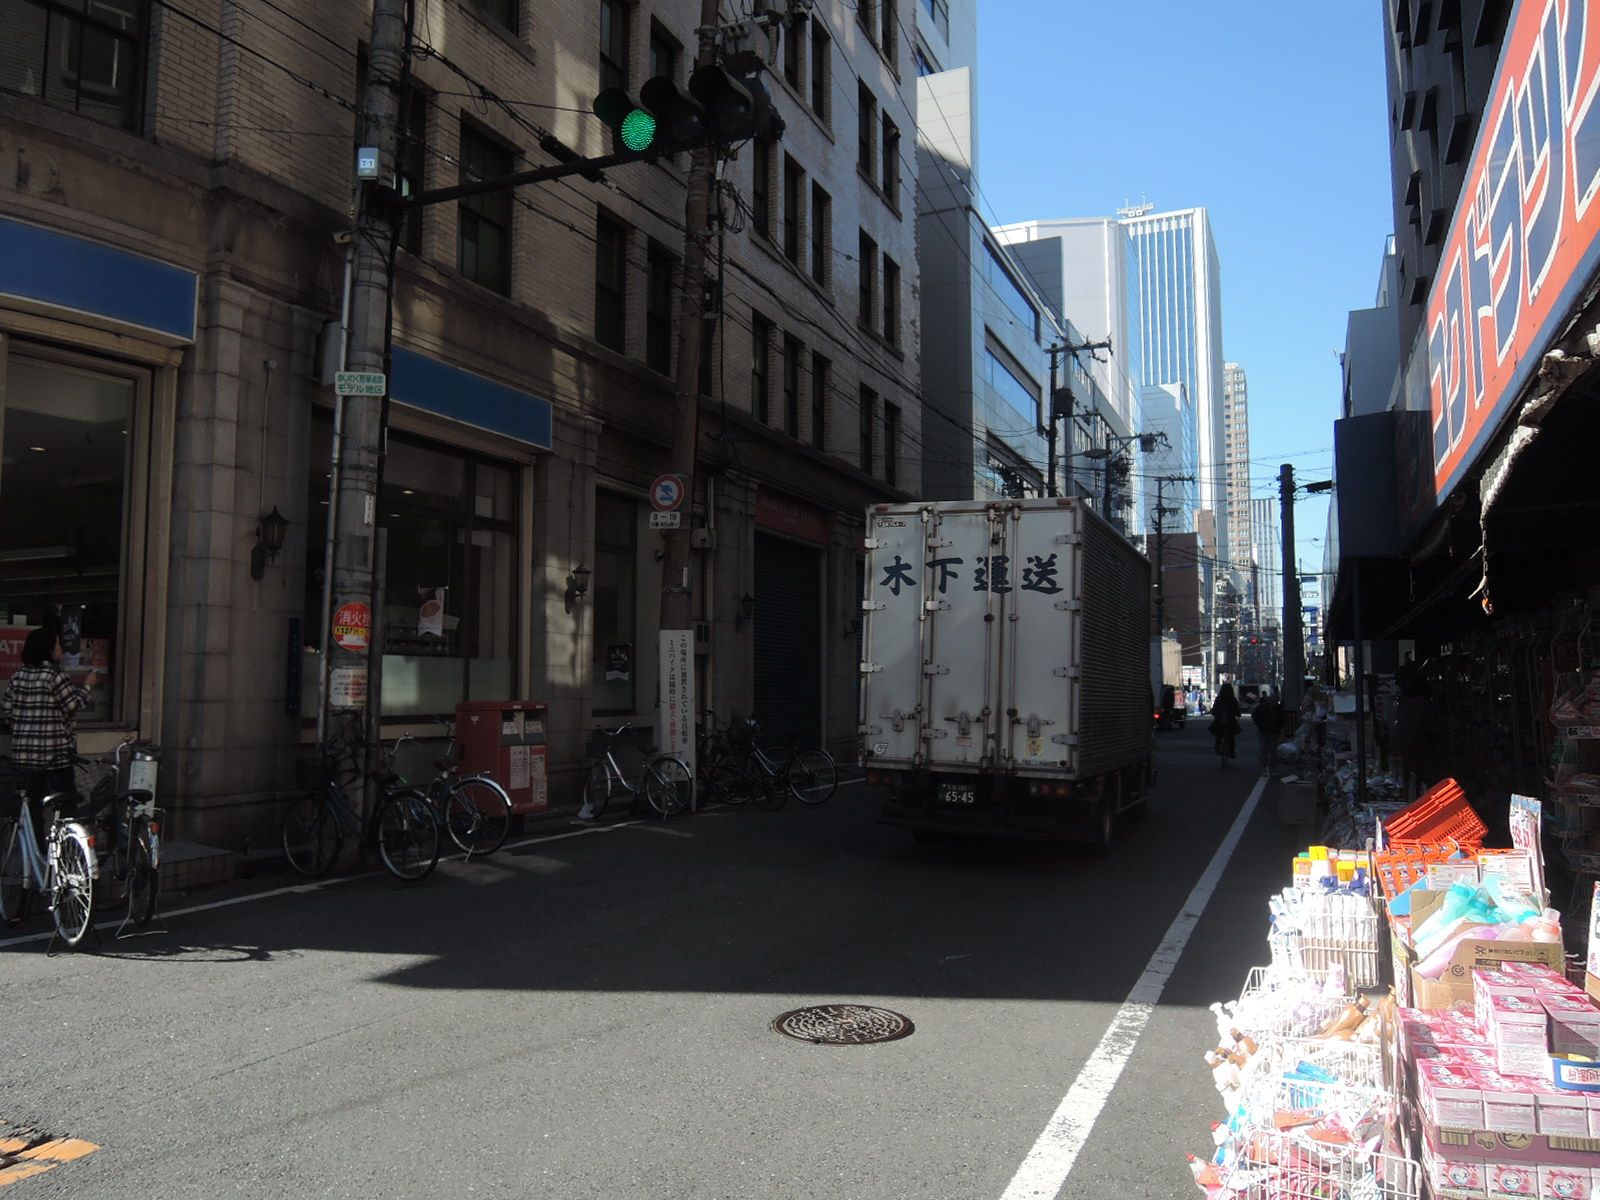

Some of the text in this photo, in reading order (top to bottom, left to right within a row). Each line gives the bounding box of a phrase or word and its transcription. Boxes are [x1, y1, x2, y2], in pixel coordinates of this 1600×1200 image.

[337, 383, 384, 394] モデル地区
[880, 553, 1064, 597] 木下運送
[945, 790, 974, 803] 65-45
